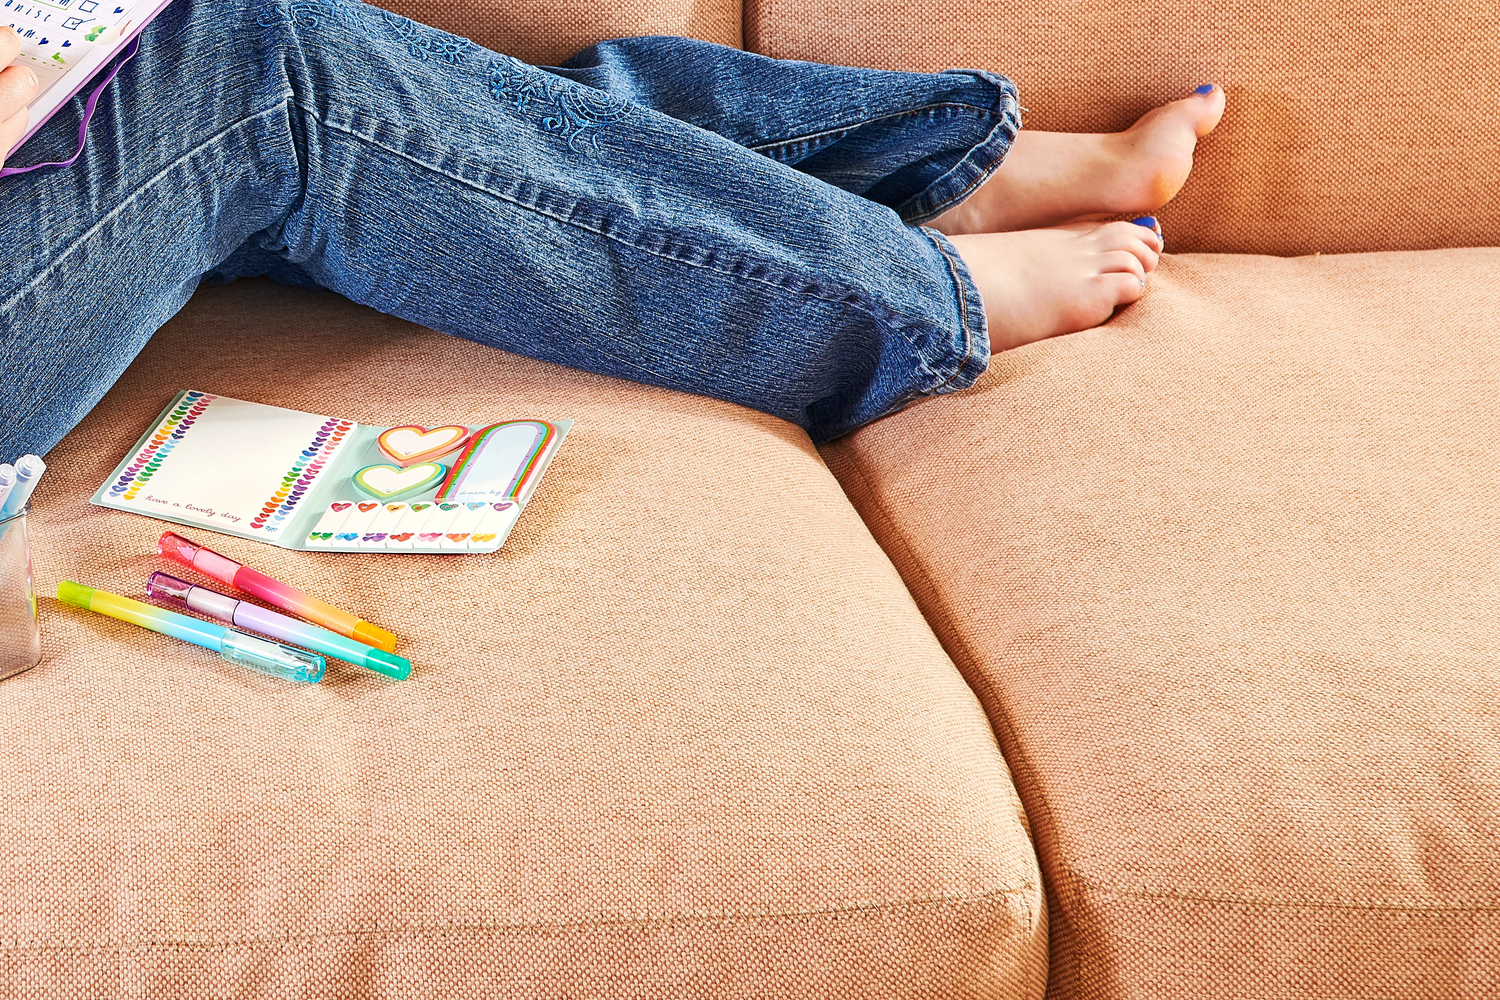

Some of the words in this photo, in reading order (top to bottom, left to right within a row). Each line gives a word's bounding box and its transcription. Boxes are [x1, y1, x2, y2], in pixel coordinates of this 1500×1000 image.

[145, 495, 169, 505] have
[185, 503, 217, 517] lovely
[220, 512, 242, 523] day
